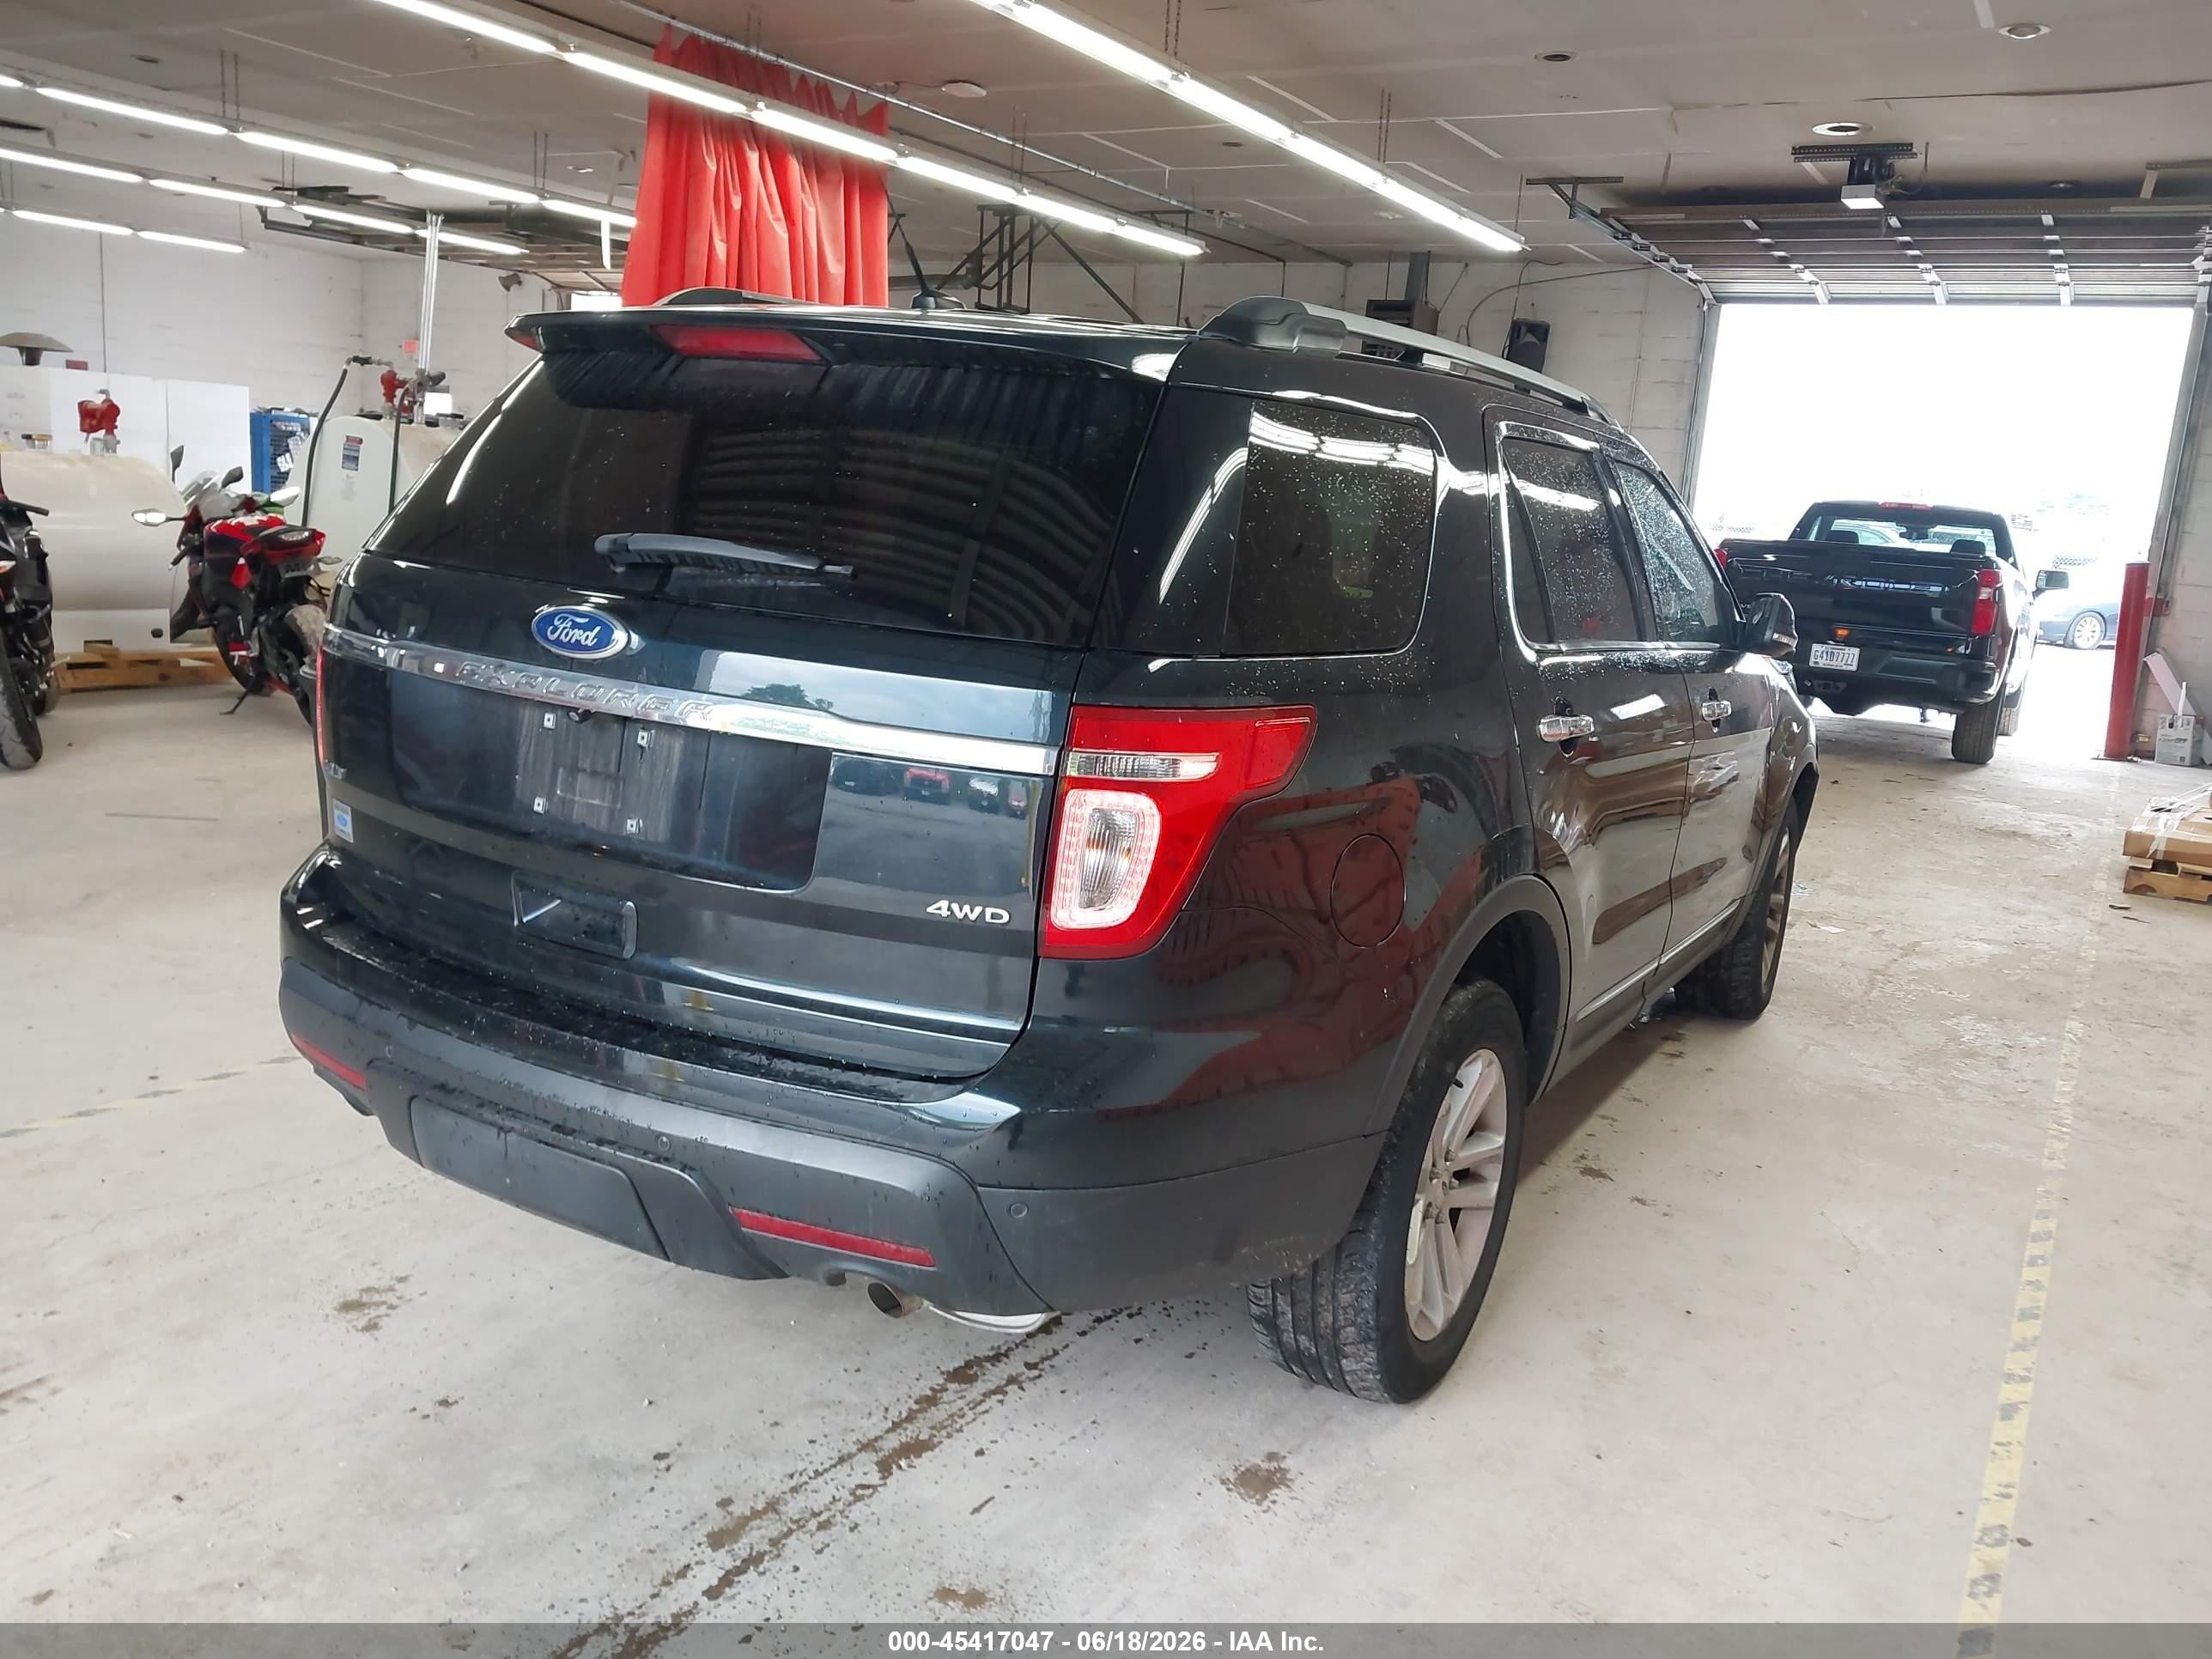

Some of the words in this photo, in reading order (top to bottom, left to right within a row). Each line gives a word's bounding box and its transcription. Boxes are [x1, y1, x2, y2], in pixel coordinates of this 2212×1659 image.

[546, 613, 602, 647] Ford
[455, 660, 715, 720] EXPLORER
[926, 899, 1011, 924] 4WD
